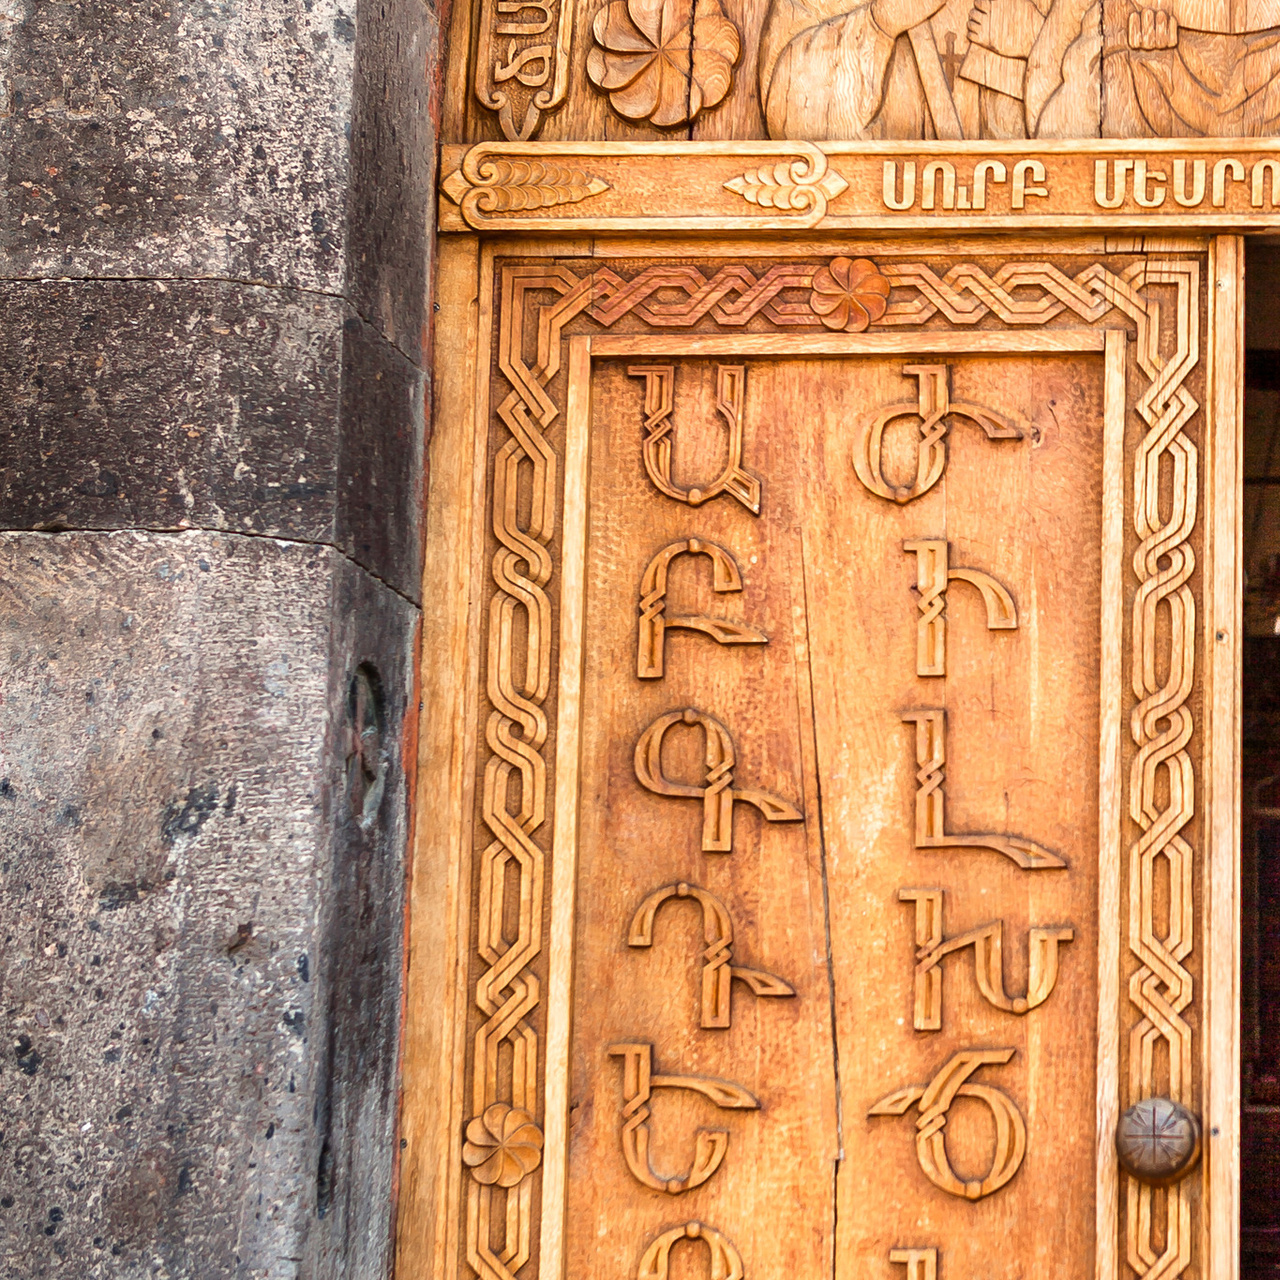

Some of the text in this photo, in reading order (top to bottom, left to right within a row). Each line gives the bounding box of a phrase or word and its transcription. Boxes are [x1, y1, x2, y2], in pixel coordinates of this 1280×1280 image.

[628, 365, 762, 516] Ա
[851, 363, 1023, 504] Ժ
[636, 538, 768, 680] Բ
[902, 539, 1018, 678] Ի
[634, 708, 804, 854] Գ
[901, 708, 1067, 870] Լ
[627, 881, 796, 1029] Դ
[899, 887, 1074, 1032] Խ
[609, 1041, 760, 1195] Ե
[867, 1047, 1027, 1200] Ծ
